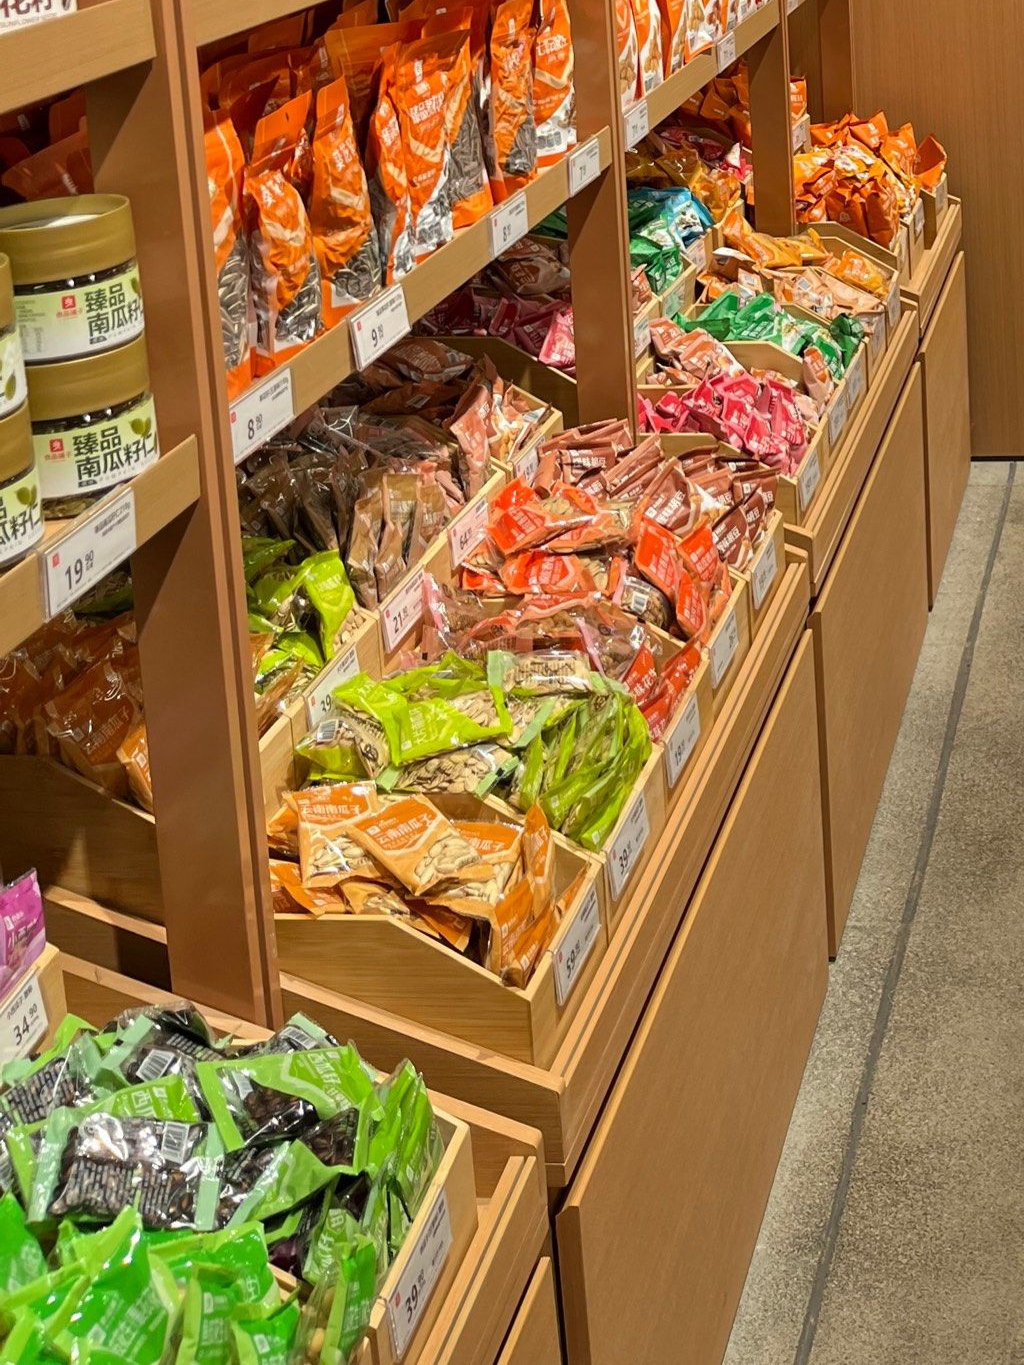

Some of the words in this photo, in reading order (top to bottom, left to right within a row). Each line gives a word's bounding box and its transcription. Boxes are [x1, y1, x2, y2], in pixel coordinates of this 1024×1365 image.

[84, 281, 126, 315] 臻品
[87, 298, 145, 337] 南瓜籽
[371, 328, 377, 348] 9
[73, 425, 122, 457] 臻品
[247, 419, 255, 440] 8
[75, 430, 157, 481] 南瓜籽仁
[65, 558, 83, 590] 19
[393, 611, 402, 634] 21
[618, 848, 628, 876] 39
[565, 950, 575, 979] 59
[13, 1016, 30, 1047] 34
[29, 1002, 38, 1019] 90
[404, 1284, 419, 1324] 39
